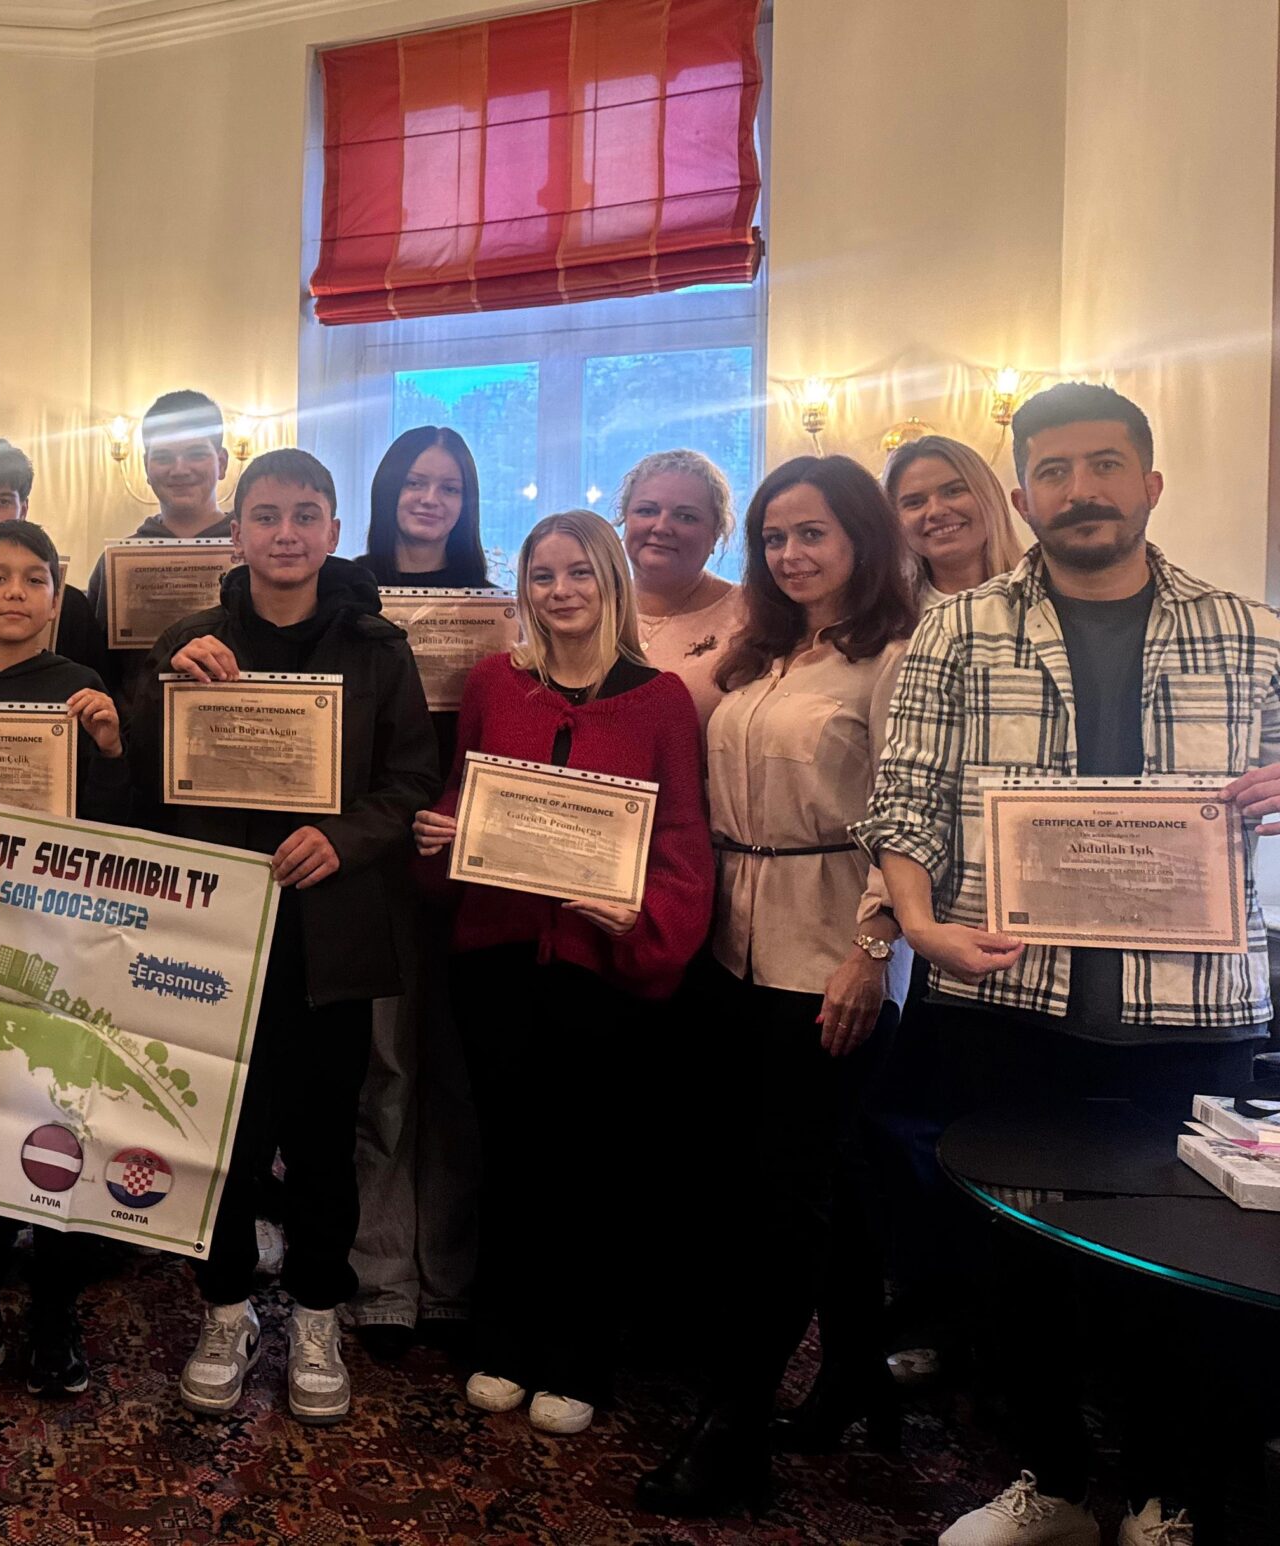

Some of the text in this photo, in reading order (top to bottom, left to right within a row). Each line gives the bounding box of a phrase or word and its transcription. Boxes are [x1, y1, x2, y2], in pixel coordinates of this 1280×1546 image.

[198, 705, 244, 713] CERTIFICATE
[256, 707, 306, 715] ATTENDANCE
[500, 790, 548, 806] CERTIFICATE
[549, 799, 560, 807] OF
[561, 801, 615, 817] ATTENDANCE
[1032, 819, 1188, 829] CERTIFICATE OF ATTENDANCE
[1069, 843, 1126, 855] Abdullah
[136, 963, 225, 995] Erasmus+
[30, 1193, 61, 1208] LATVIA
[111, 1209, 149, 1225] CROATIA
